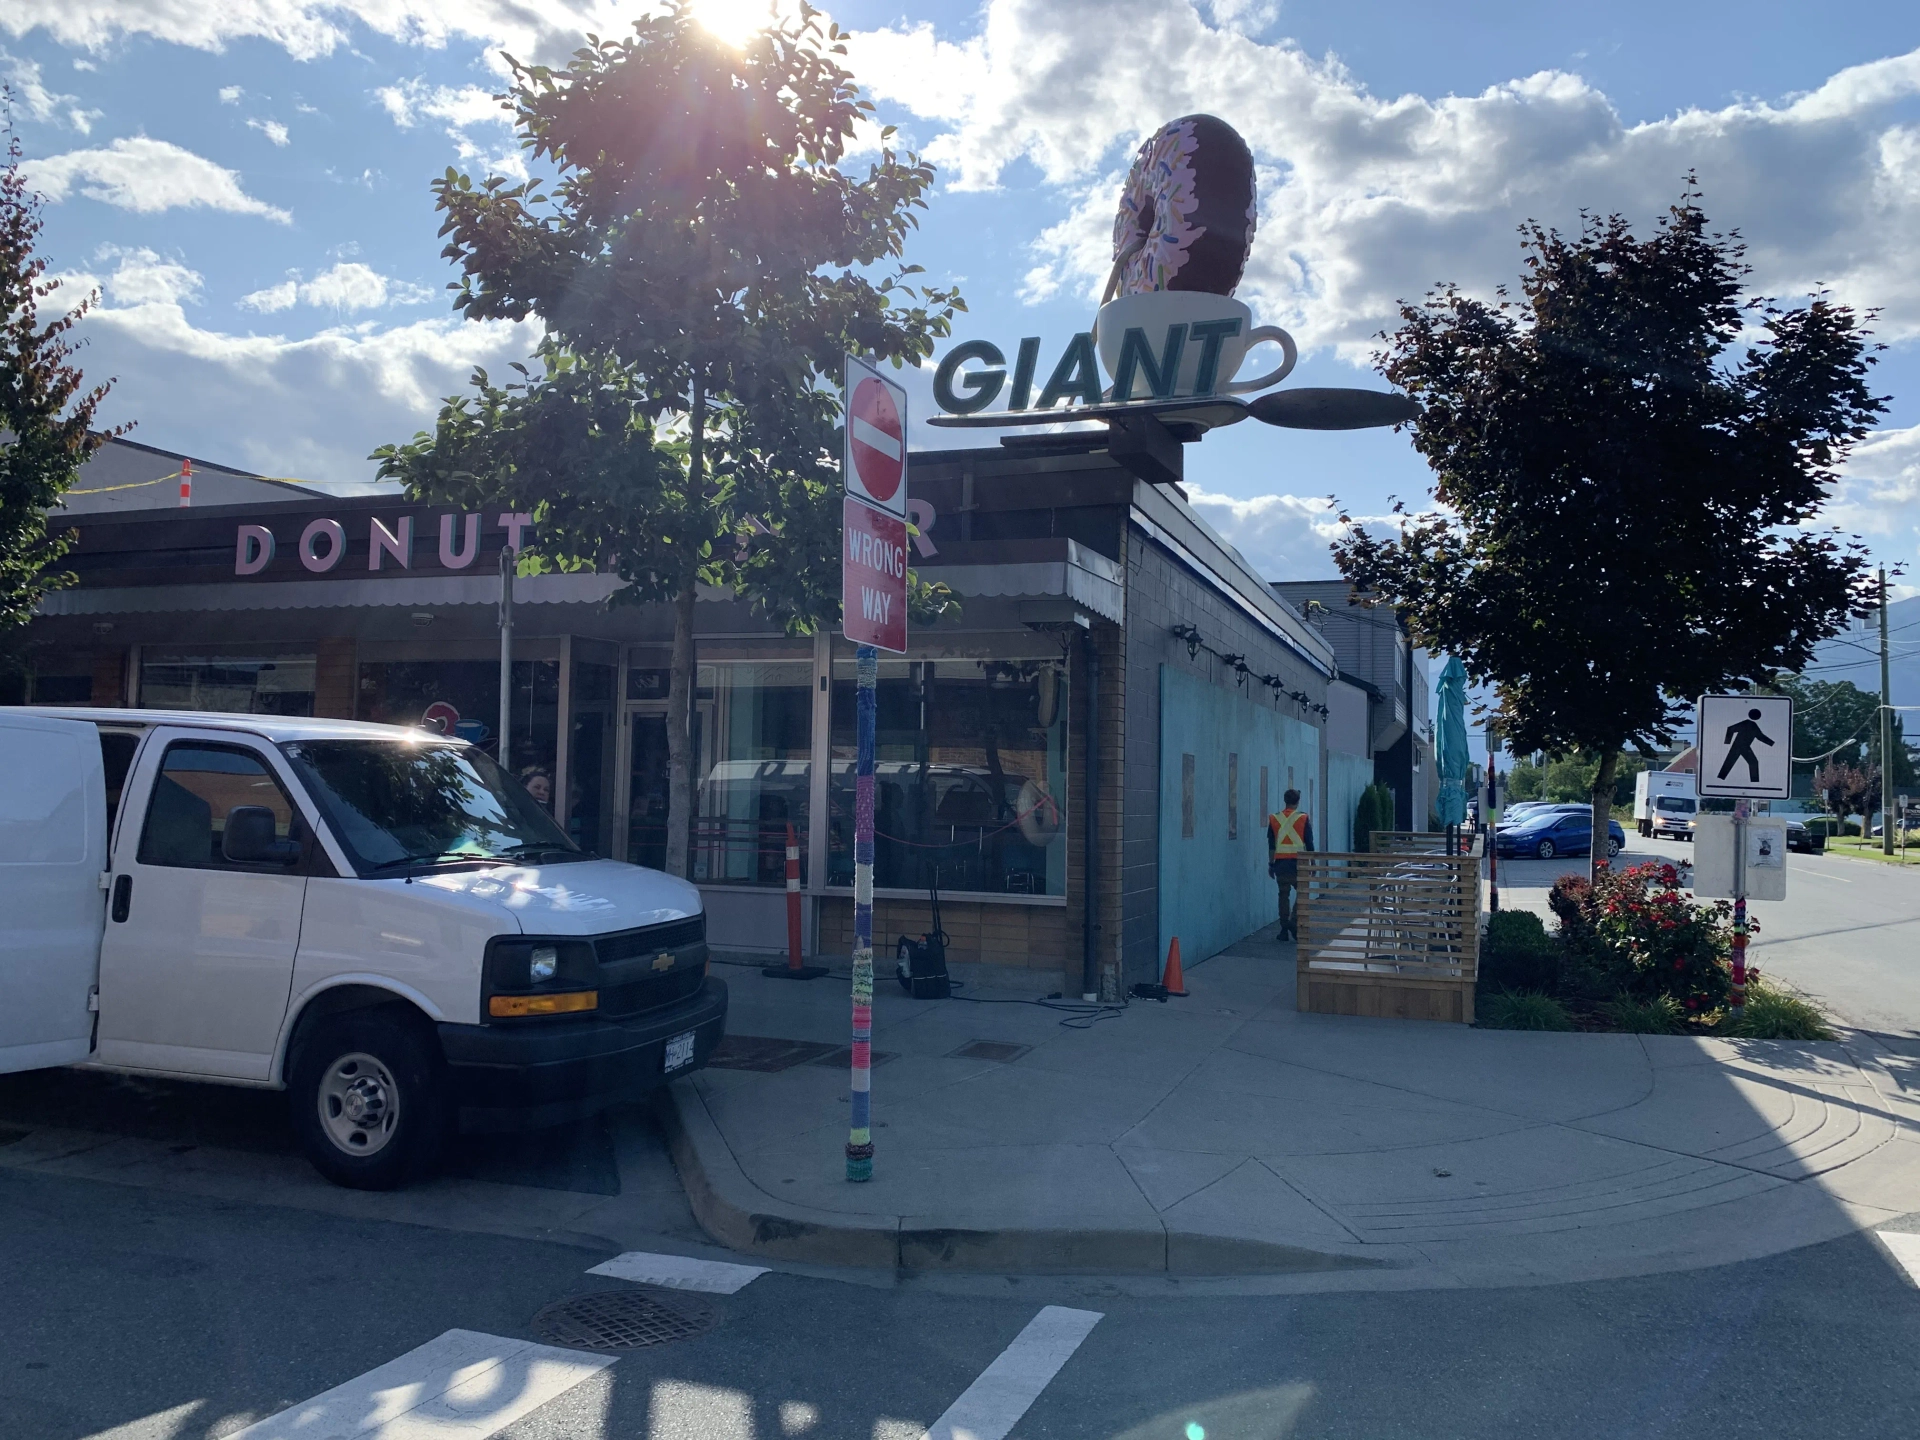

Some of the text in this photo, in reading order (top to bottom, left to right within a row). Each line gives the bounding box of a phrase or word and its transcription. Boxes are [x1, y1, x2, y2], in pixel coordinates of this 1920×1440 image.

[933, 318, 1243, 414] GIANT
[234, 512, 534, 575] DONUT
[849, 527, 904, 579] WRONG
[862, 585, 892, 625] WAY
